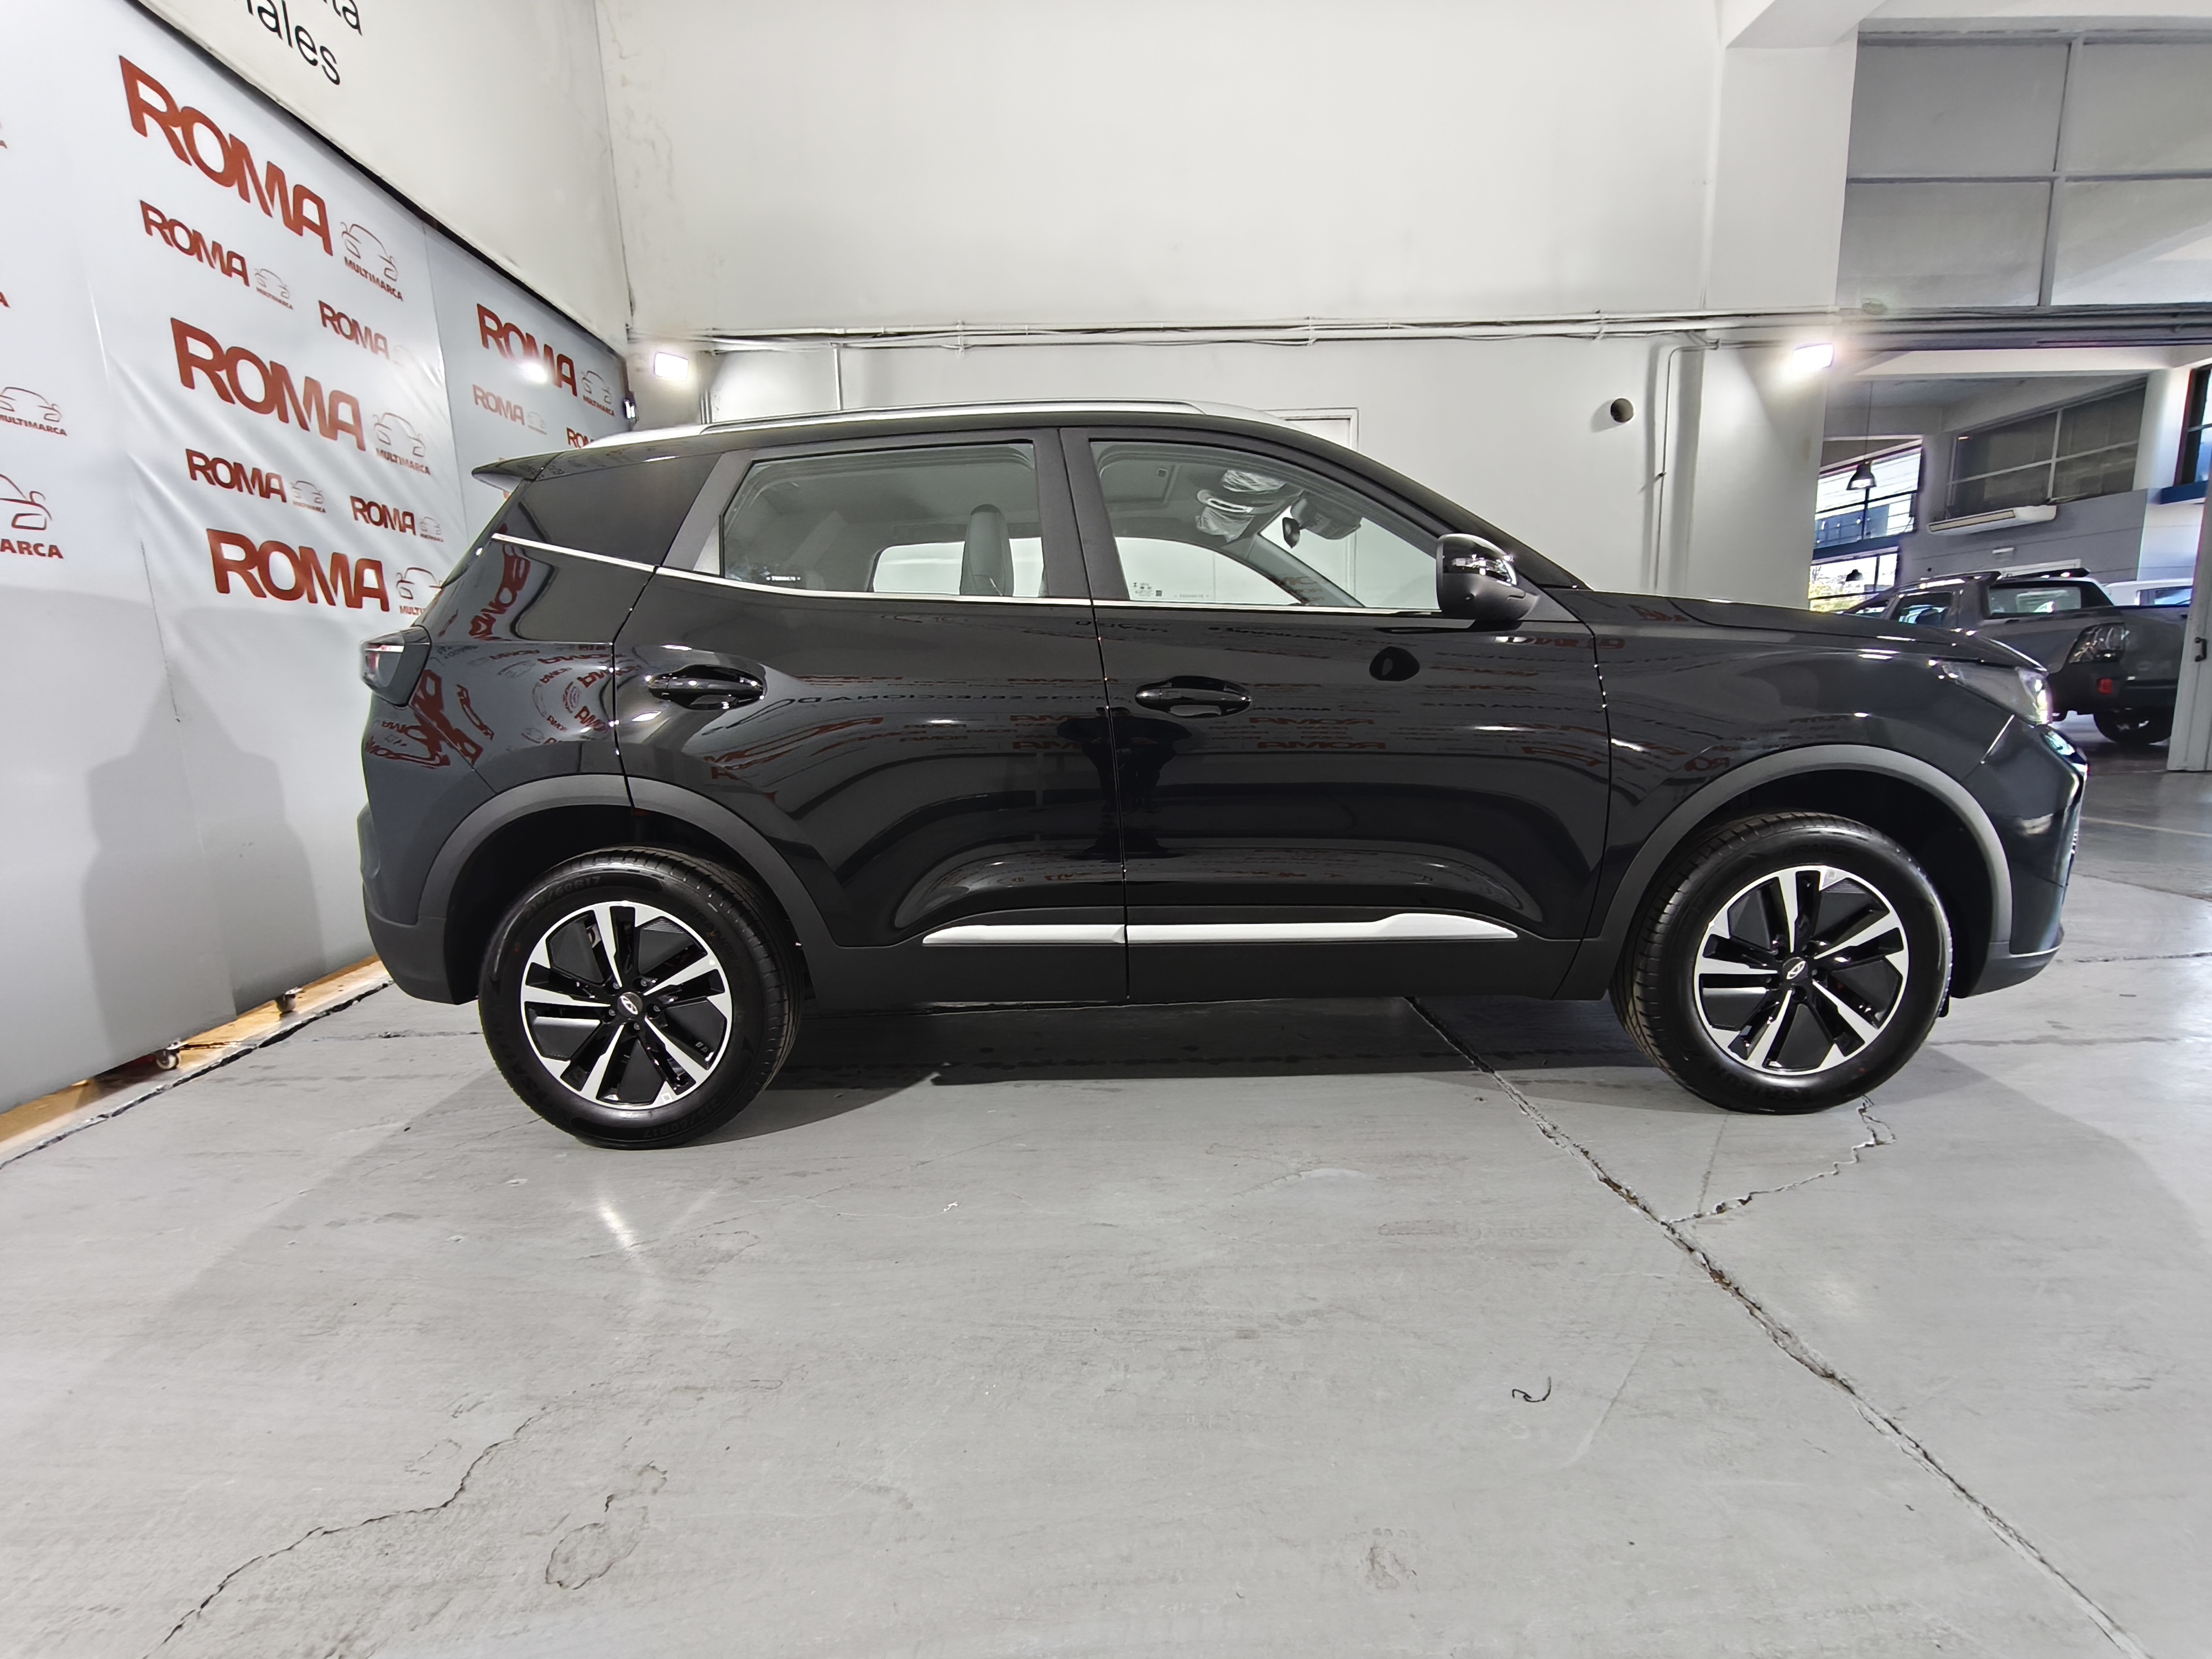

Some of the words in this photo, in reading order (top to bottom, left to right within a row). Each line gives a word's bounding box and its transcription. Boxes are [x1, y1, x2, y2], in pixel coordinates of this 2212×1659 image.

[119, 55, 333, 257] ROMA
[140, 199, 249, 288] ROMA
[345, 257, 403, 301] MULTIMARCA
[318, 300, 390, 361] ROMA
[477, 302, 577, 397] ROMA
[171, 317, 366, 451] ROMA
[472, 384, 525, 426] ROMA
[185, 448, 287, 503] ROMA
[376, 447, 431, 475] MULTIMARCA
[350, 495, 417, 536] ROMA
[206, 529, 390, 613] ROMA
